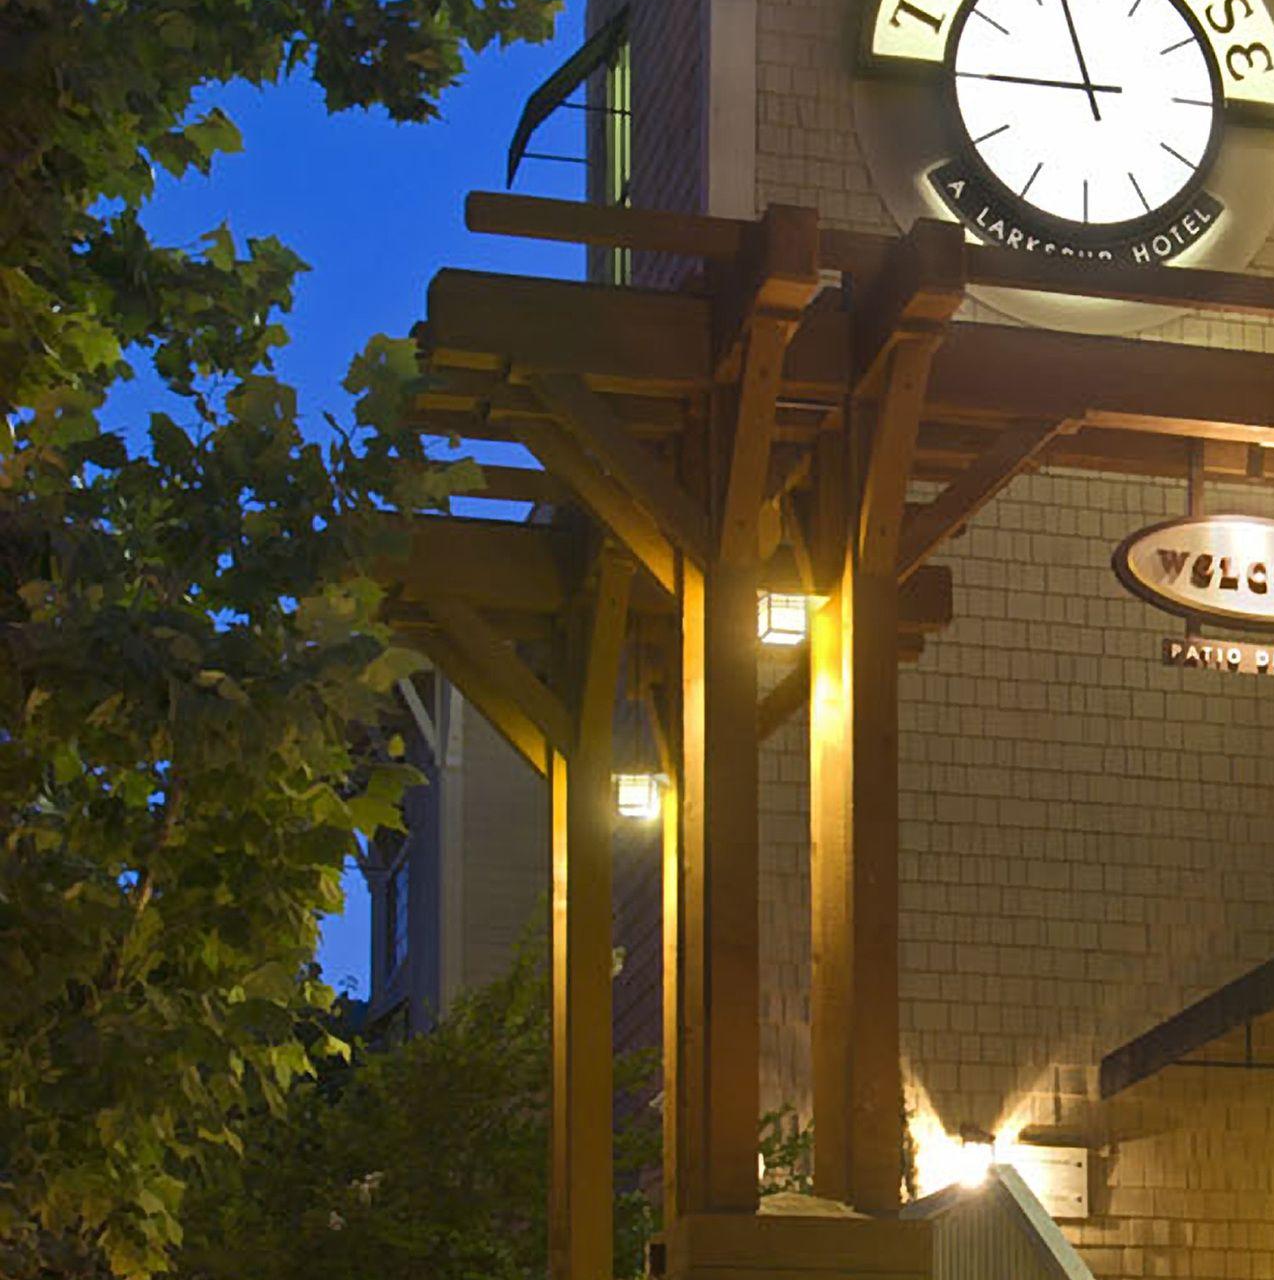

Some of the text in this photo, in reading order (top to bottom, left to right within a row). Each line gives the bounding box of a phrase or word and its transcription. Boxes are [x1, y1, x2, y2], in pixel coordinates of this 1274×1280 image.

[946, 178, 967, 200] A
[1131, 208, 1212, 264] HOTEL
[1170, 642, 1242, 666] PATIO
